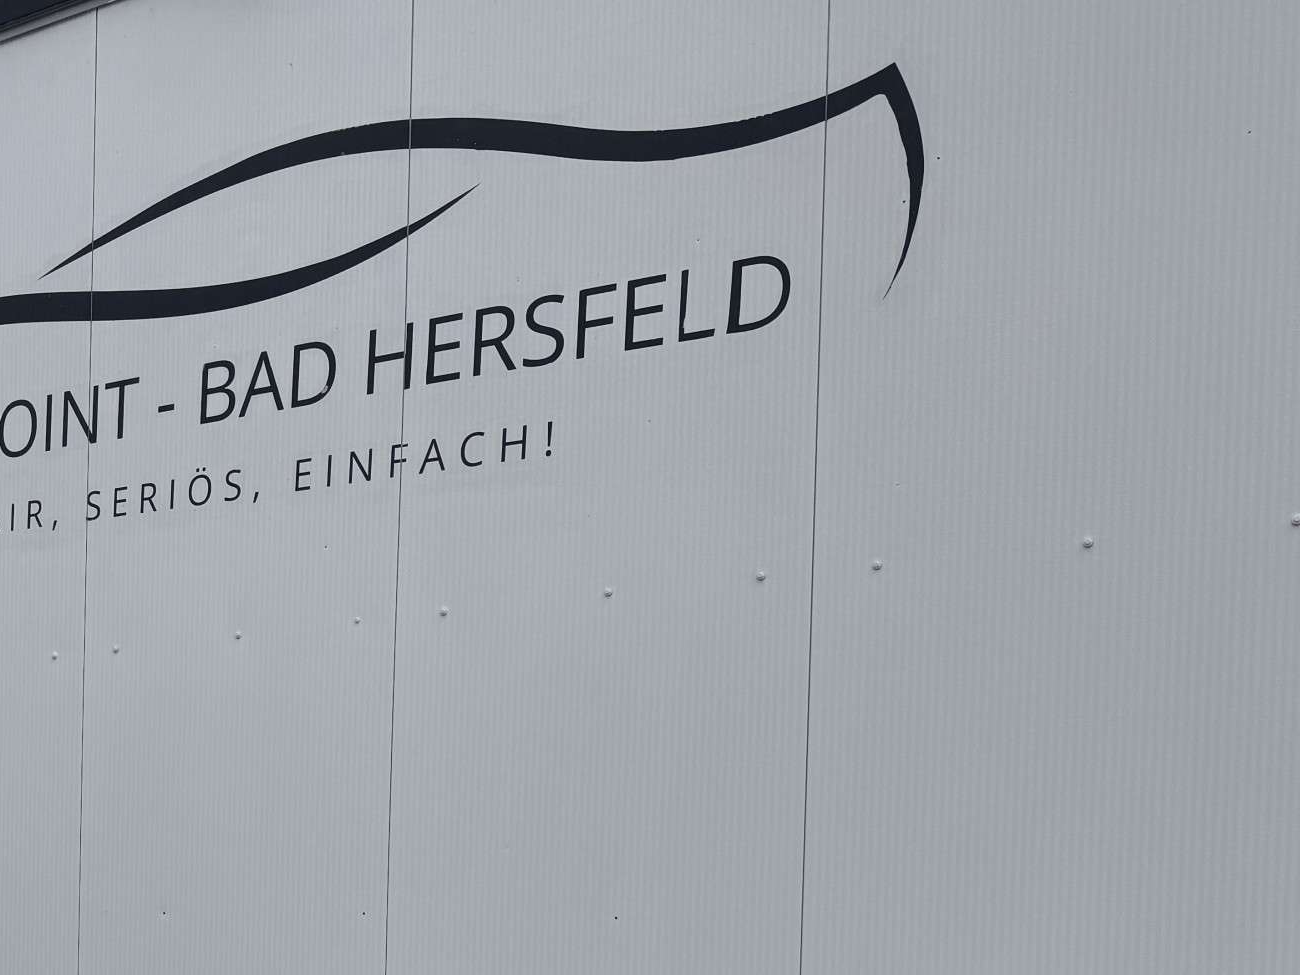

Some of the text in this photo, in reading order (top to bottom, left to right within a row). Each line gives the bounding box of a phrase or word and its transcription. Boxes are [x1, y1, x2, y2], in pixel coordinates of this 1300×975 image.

[157, 402, 175, 413] -
[200, 340, 337, 424] BAD
[366, 255, 792, 395] HERSFELD
[86, 467, 260, 521] SERIÖS,
[294, 421, 554, 492] EINFACH!
